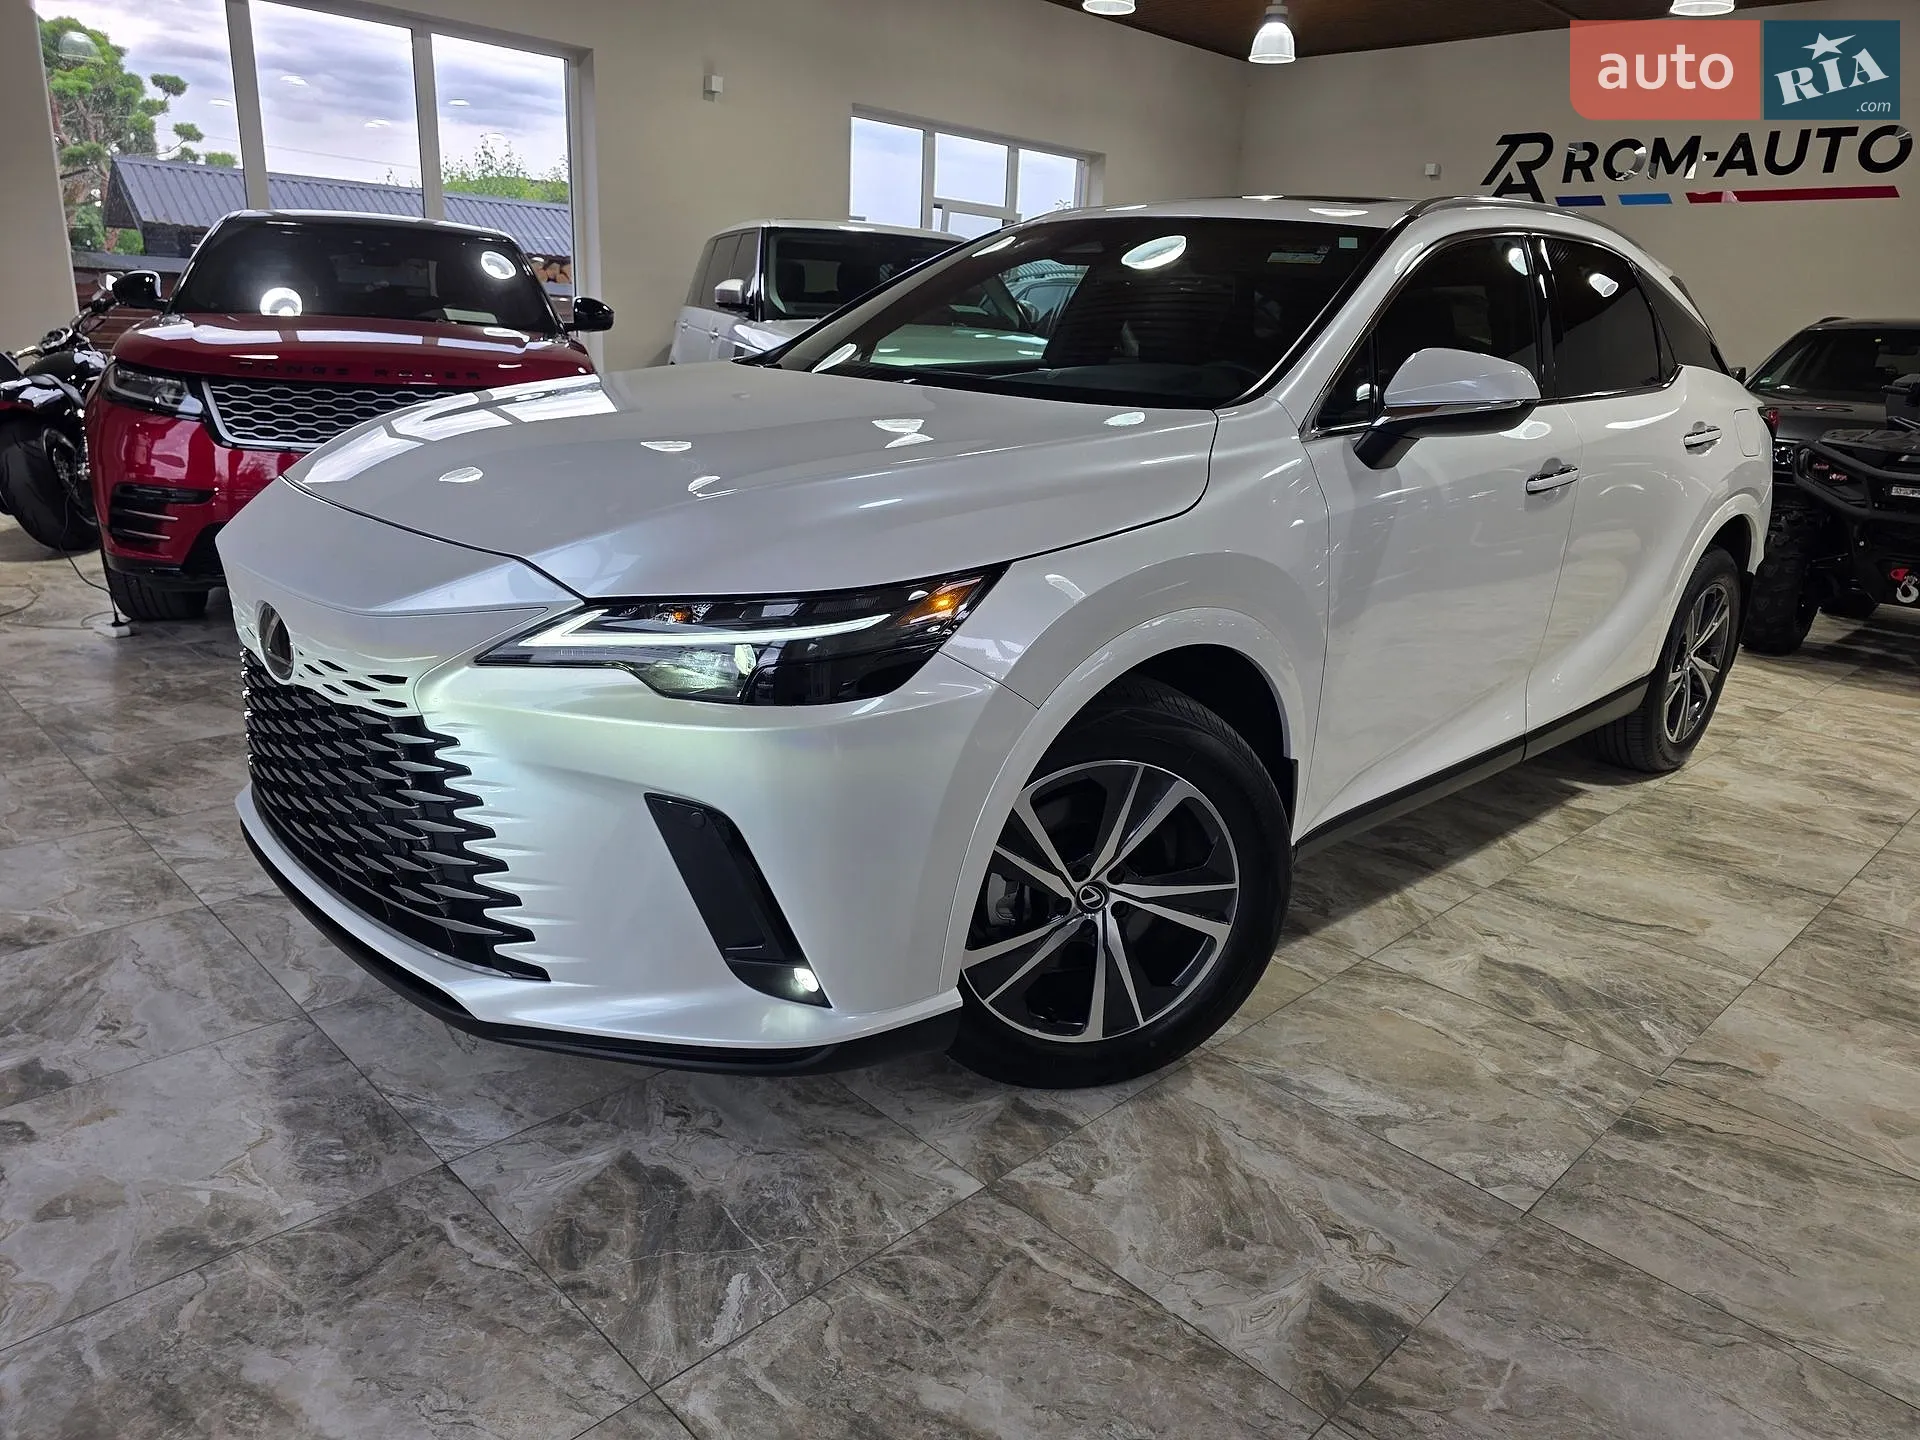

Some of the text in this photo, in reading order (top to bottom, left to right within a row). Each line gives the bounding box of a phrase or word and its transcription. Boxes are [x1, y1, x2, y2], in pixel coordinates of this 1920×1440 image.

[1562, 125, 1913, 183] ROM-AUTO
[238, 361, 481, 380] RANGE ROVER
